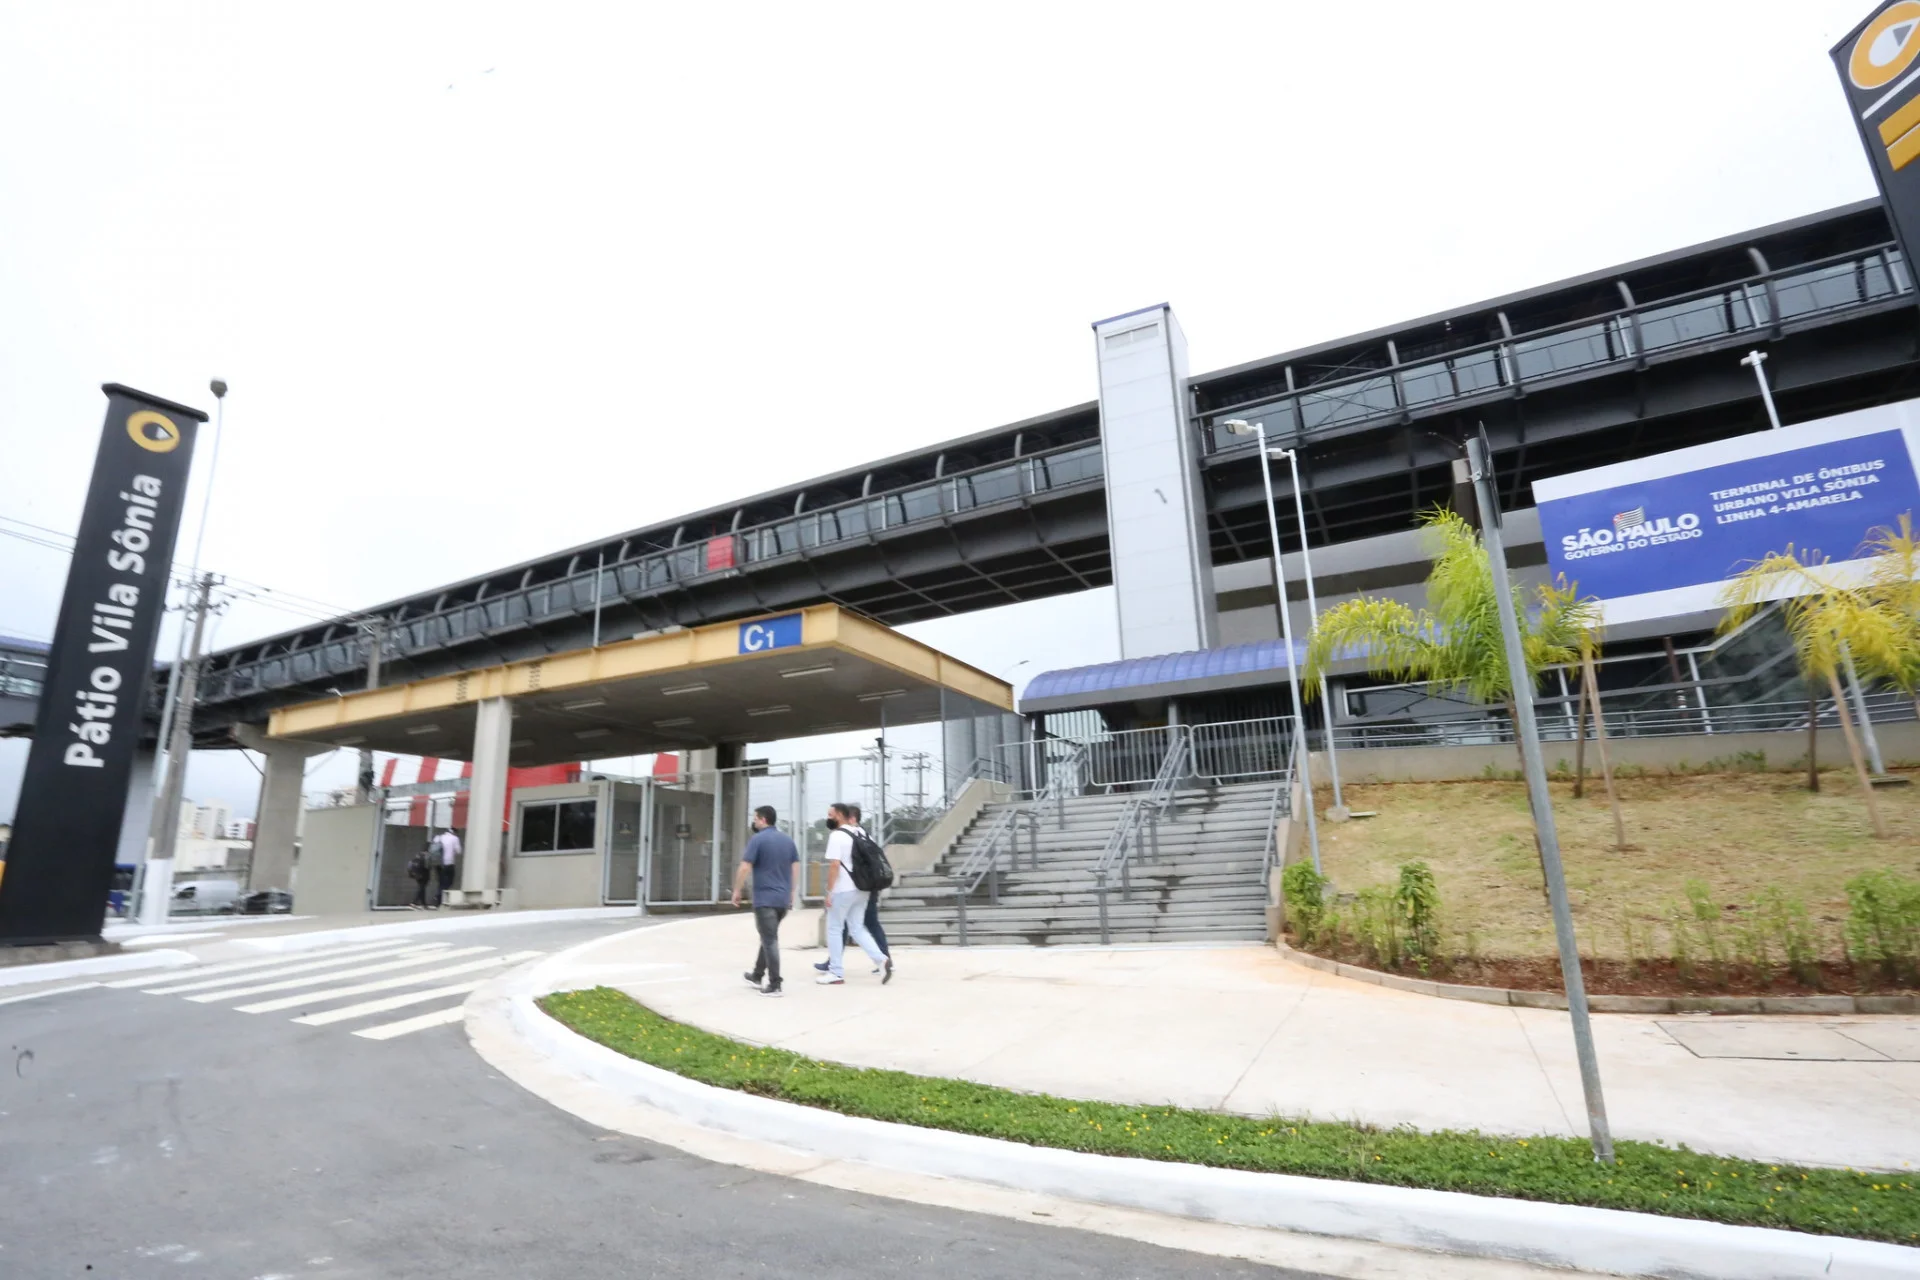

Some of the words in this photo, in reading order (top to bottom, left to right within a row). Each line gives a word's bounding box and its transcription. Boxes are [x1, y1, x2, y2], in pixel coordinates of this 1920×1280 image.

[1709, 478, 1791, 500] TERMINAL
[1792, 472, 1816, 485] DE
[1818, 459, 1886, 480] ÔNIBUS
[1713, 492, 1779, 512] URBANO
[1781, 485, 1821, 499] VILA
[1824, 474, 1880, 492] SÔNIA
[107, 474, 162, 575] Sônia
[1716, 508, 1767, 525] LINHA
[1769, 490, 1864, 515] 4-AMARELA
[1562, 527, 1613, 551] SÃO
[1616, 513, 1700, 542] PAULO
[1564, 542, 1625, 560] GOVERNO
[1627, 538, 1648, 550] DO
[1651, 528, 1703, 545] ESTADO
[88, 583, 141, 653] Vila
[744, 624, 775, 651] C1
[64, 666, 122, 768] Pátio
